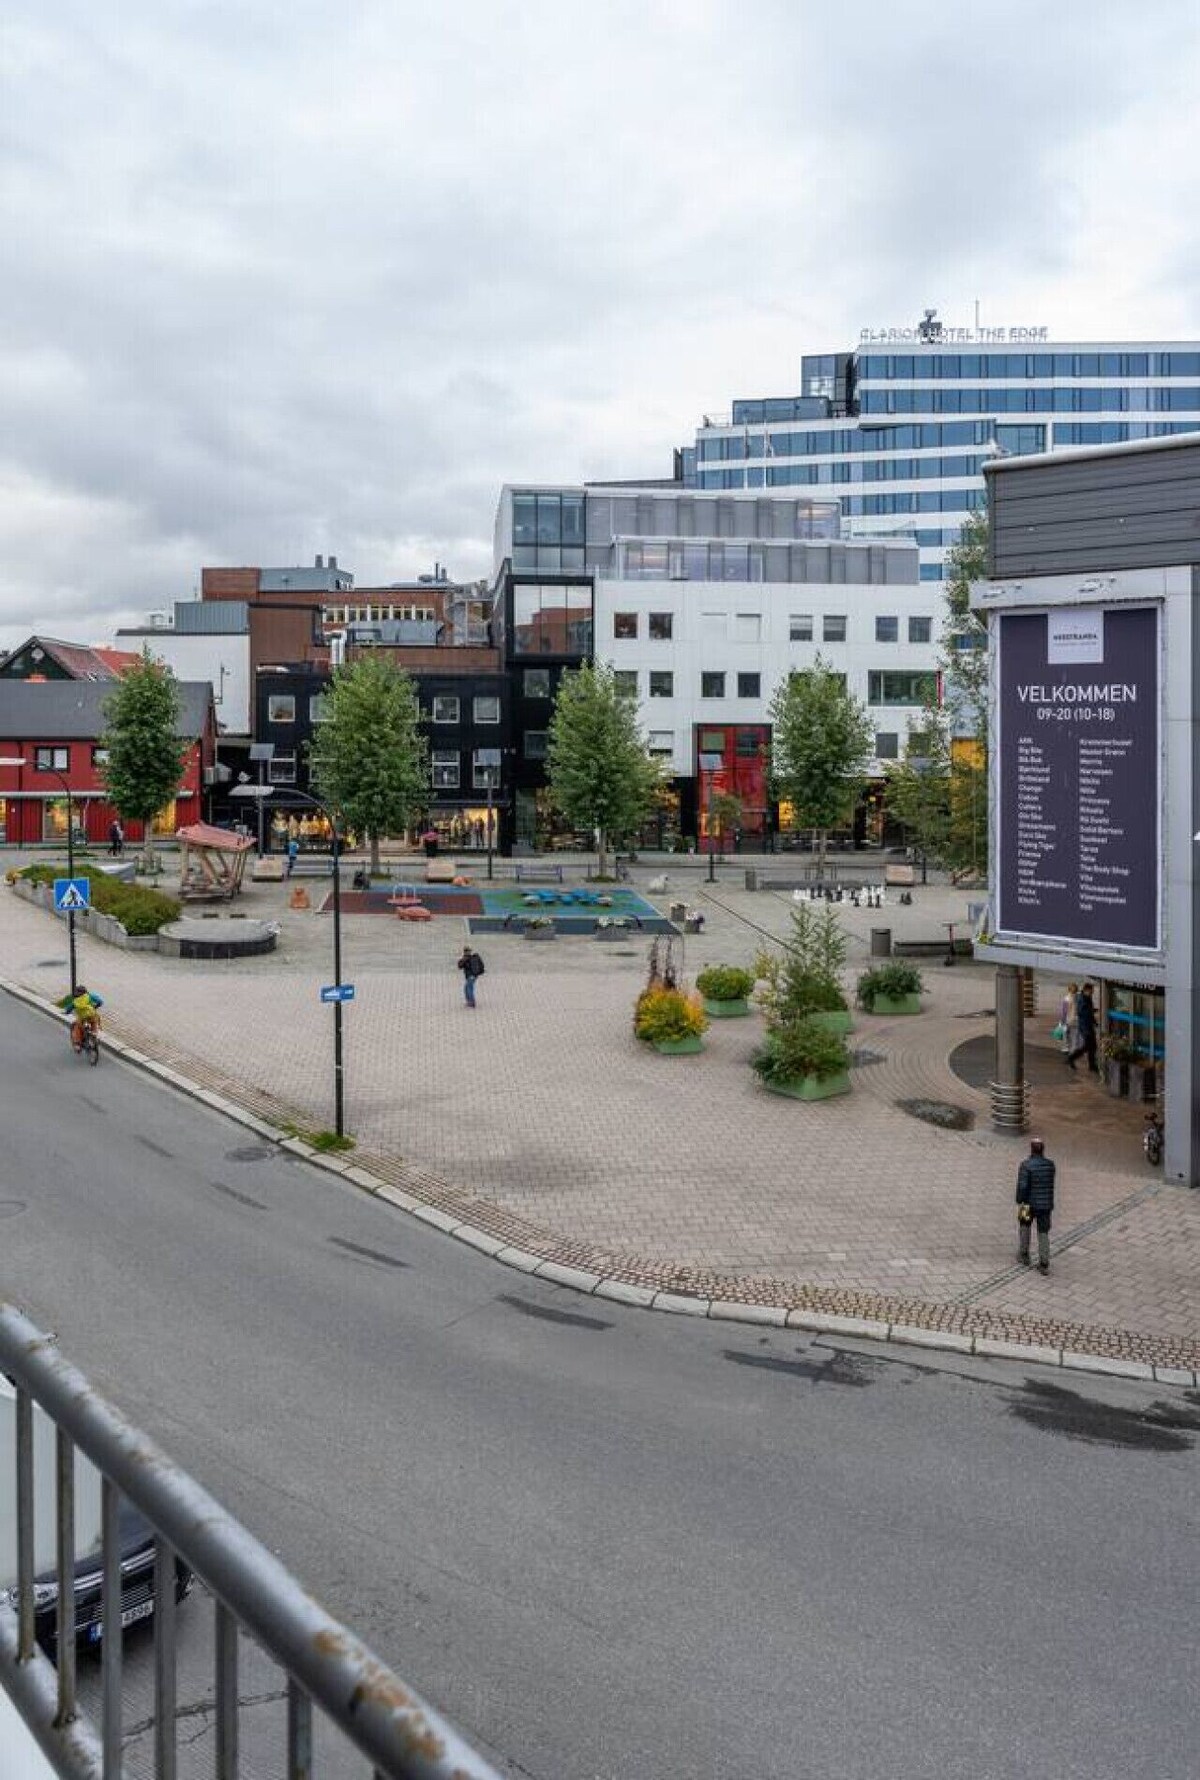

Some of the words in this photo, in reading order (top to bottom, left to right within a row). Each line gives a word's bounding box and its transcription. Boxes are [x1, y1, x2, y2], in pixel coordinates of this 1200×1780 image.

[976, 327, 1005, 340] THE
[1009, 326, 1048, 339] EDGE
[1017, 683, 1137, 703] VELKOMMEN
[1036, 707, 1071, 721] 09-20
[1074, 707, 1116, 722] (10-18)
